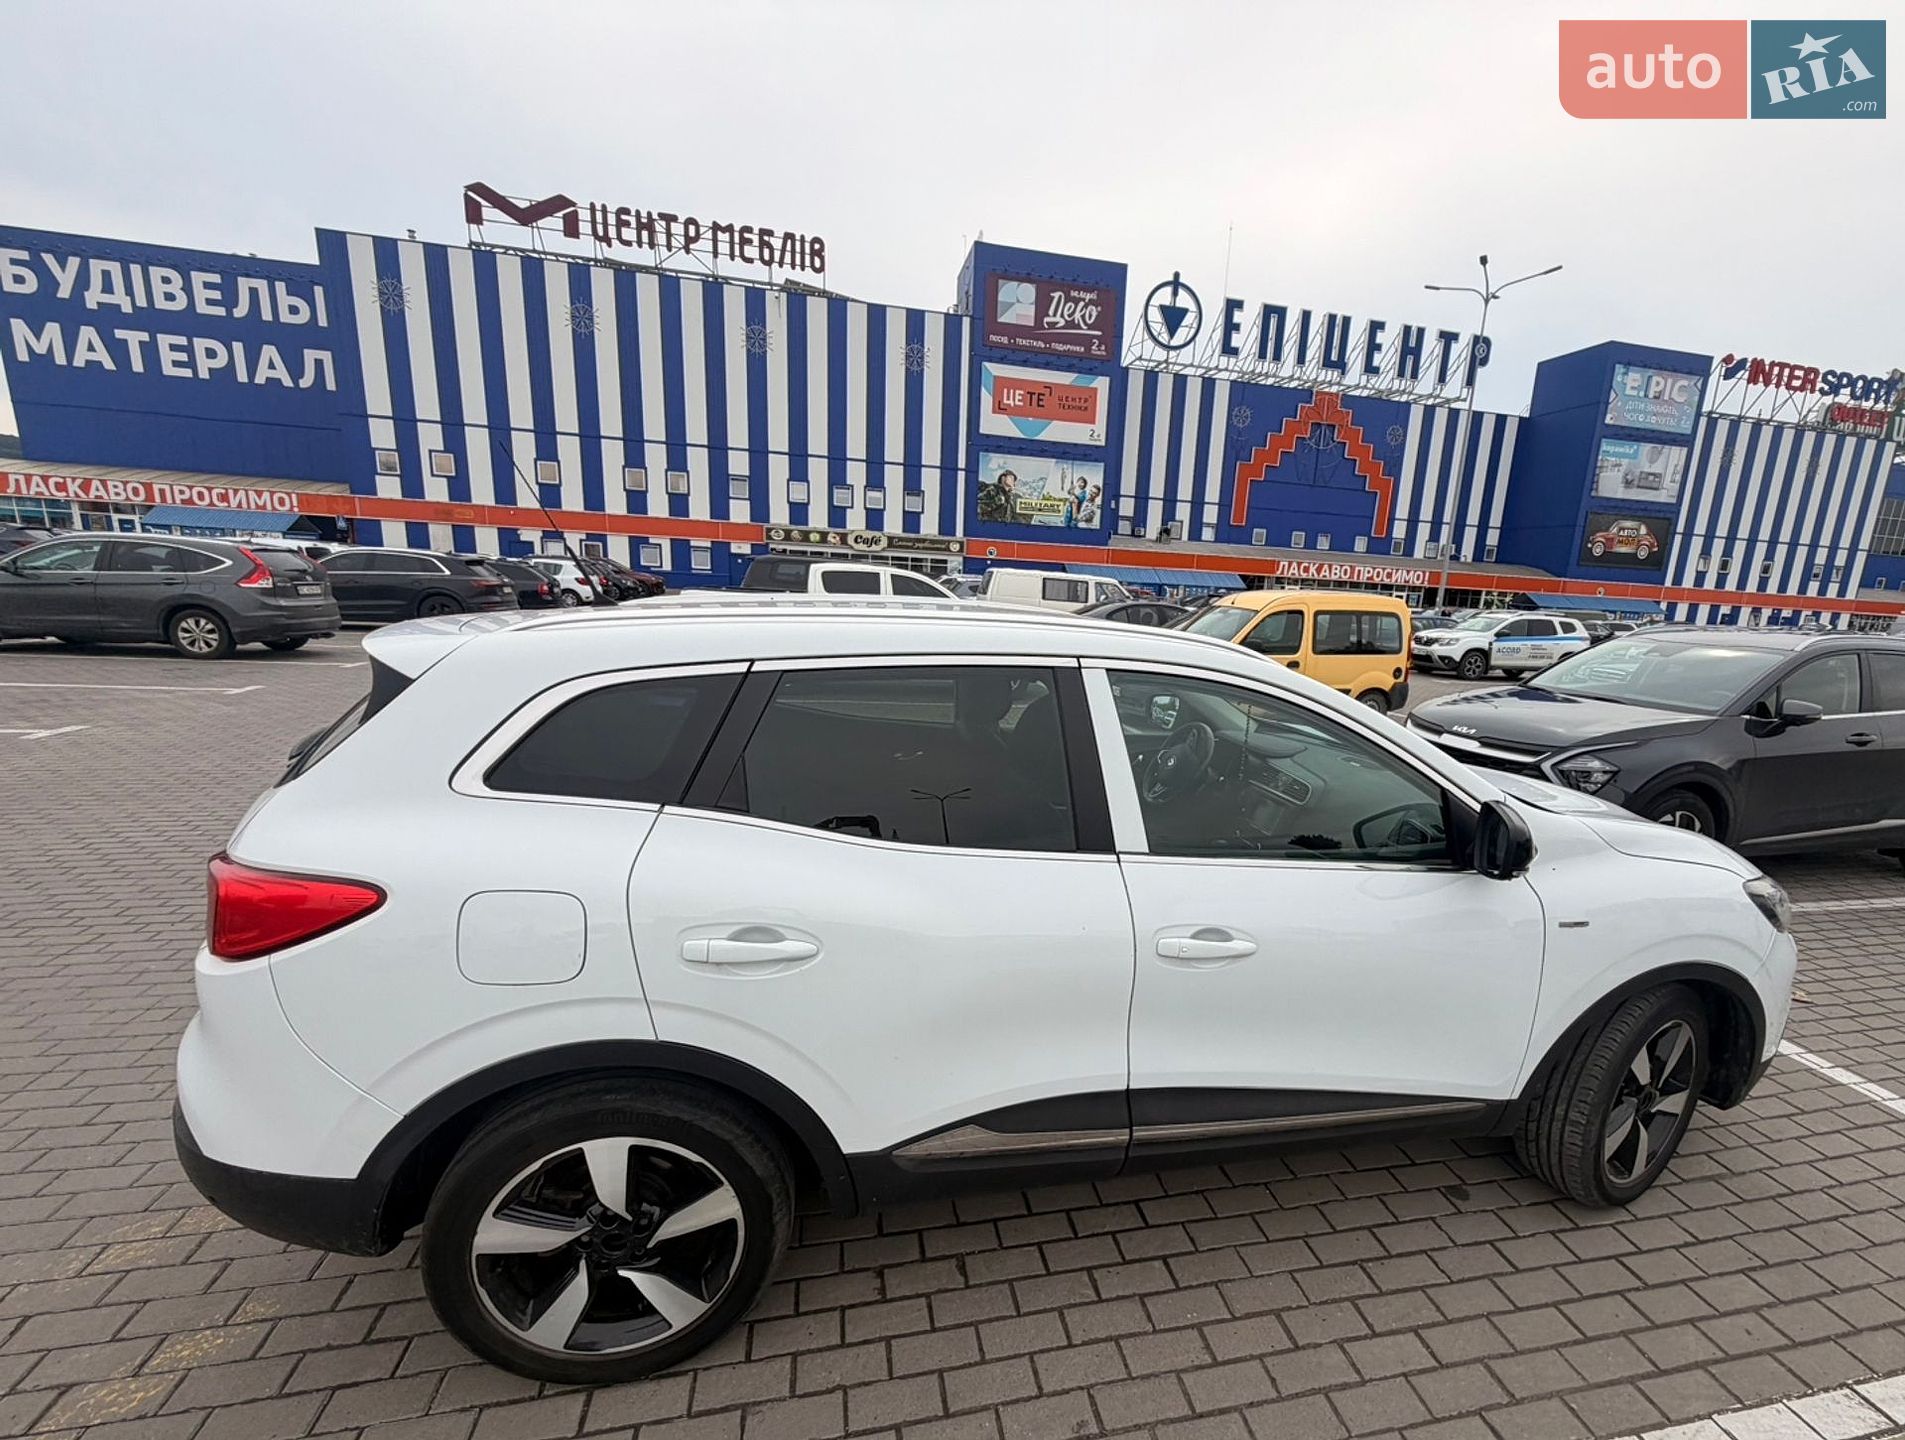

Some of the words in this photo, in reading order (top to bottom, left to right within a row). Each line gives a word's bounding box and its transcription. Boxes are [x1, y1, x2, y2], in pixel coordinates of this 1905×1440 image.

[589, 201, 701, 255] ЦЕНТР
[712, 220, 825, 274] МЕБЛІВ
[9, 318, 337, 391] МАТЕРІАЛ
[1221, 297, 1492, 388] ЕПІЦЕНТР
[1057, 395, 1089, 404] ЦЕНТР
[6, 473, 146, 502] ЛАСКАВО
[152, 484, 299, 512] ПРОСИМО!
[1019, 501, 1062, 509] MILITARY
[854, 534, 882, 548] Café
[1276, 561, 1350, 579] ЛАСКАВО
[1353, 566, 1430, 585] ПРОСИМО!
